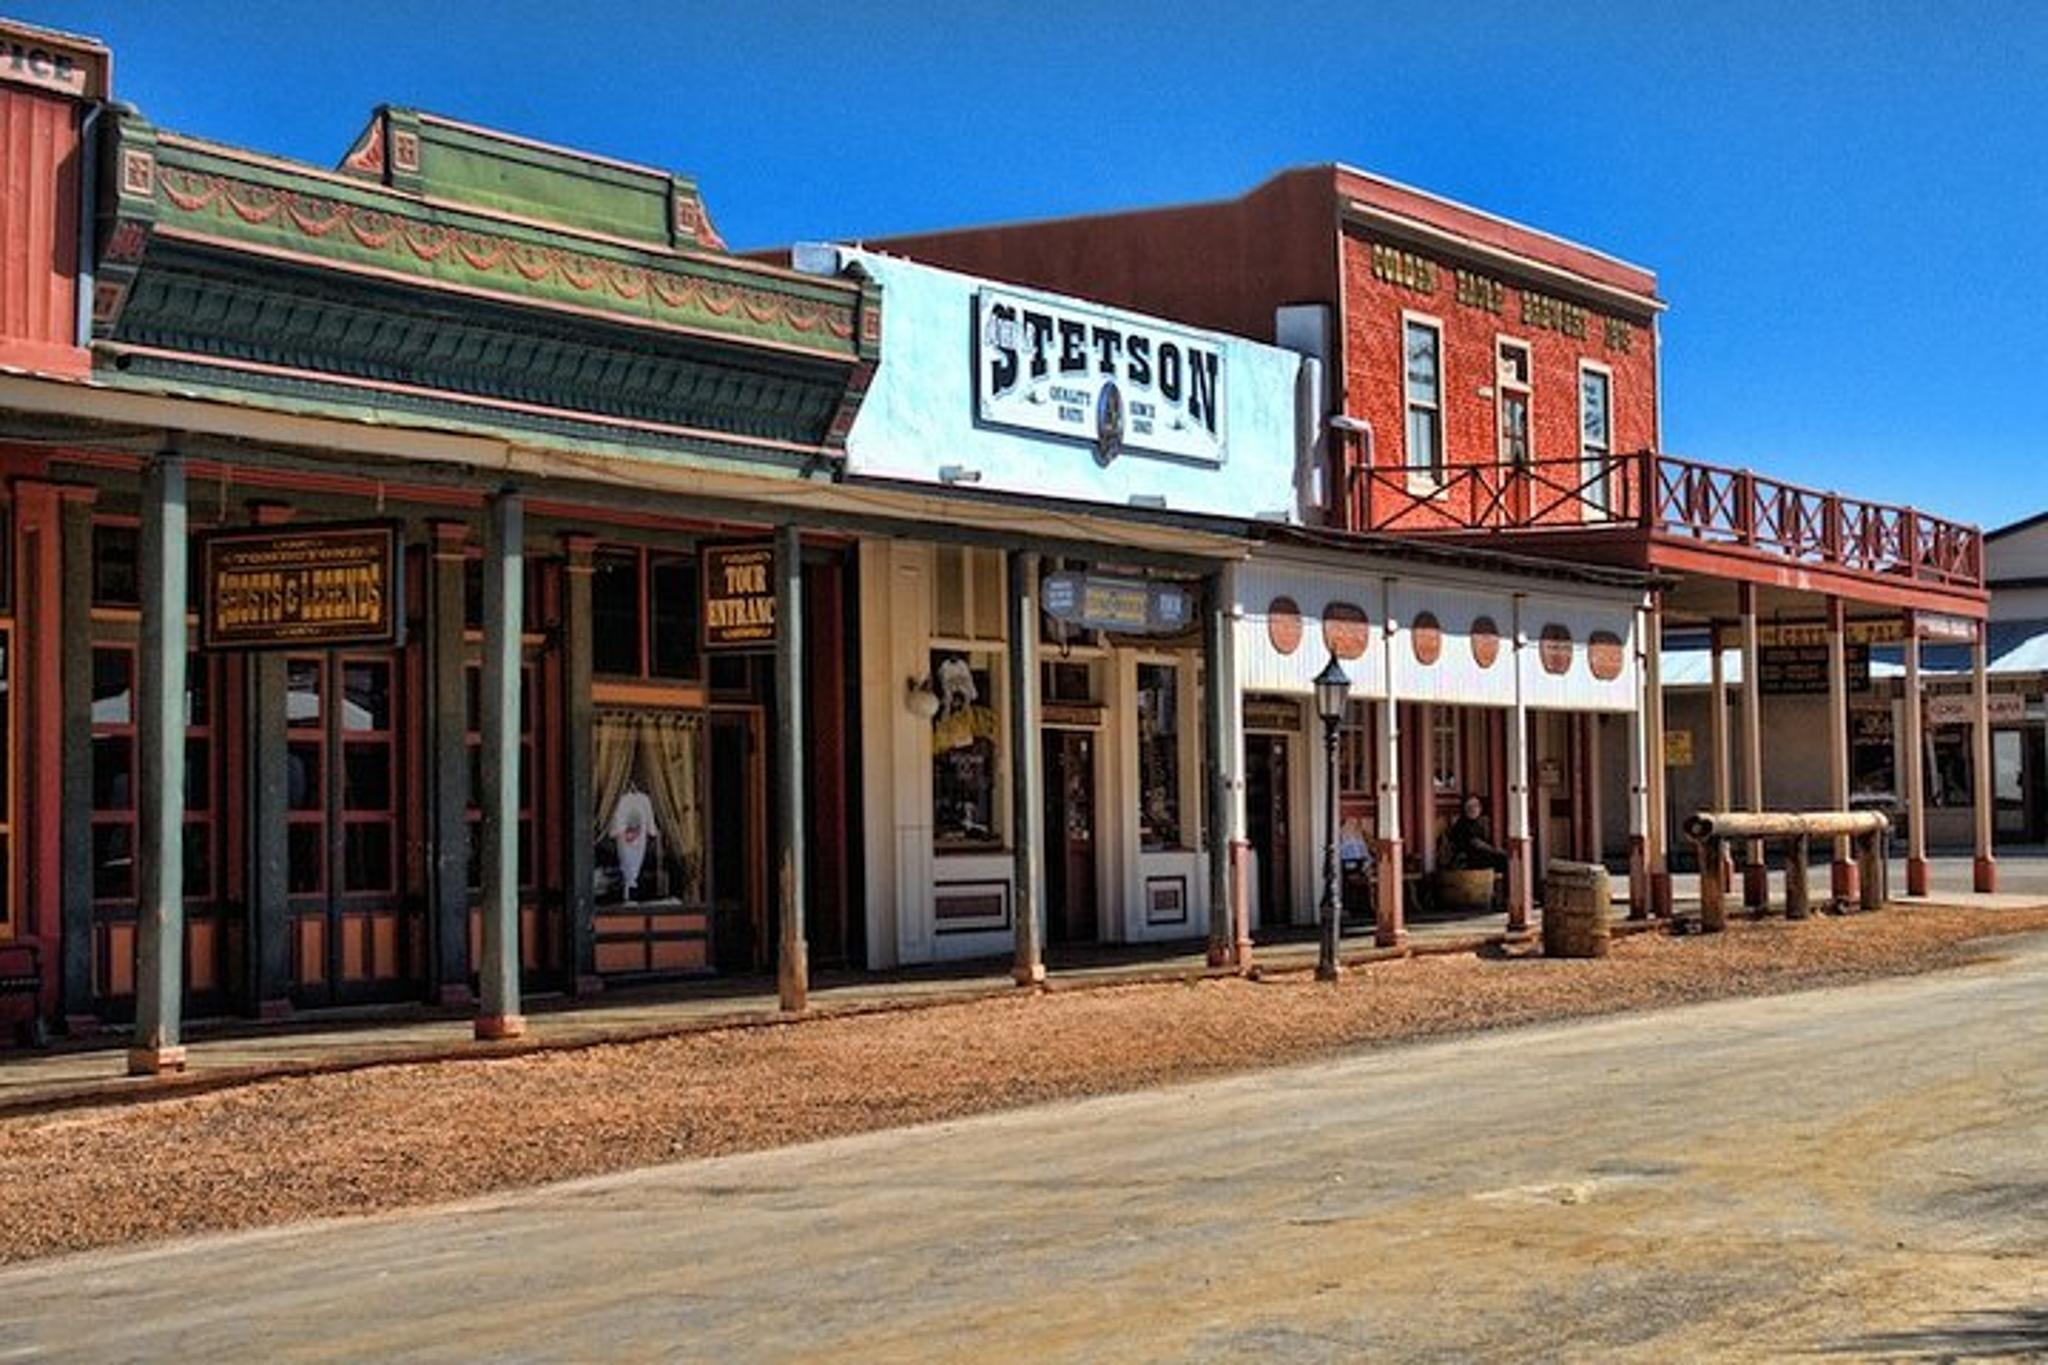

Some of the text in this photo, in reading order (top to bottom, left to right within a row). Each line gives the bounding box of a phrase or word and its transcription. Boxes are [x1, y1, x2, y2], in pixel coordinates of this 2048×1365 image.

[1371, 243, 1438, 296] GOLDEN
[991, 303, 1218, 435] STETSON
[725, 564, 766, 595] TOUR
[708, 596, 777, 627] ENTRANC
